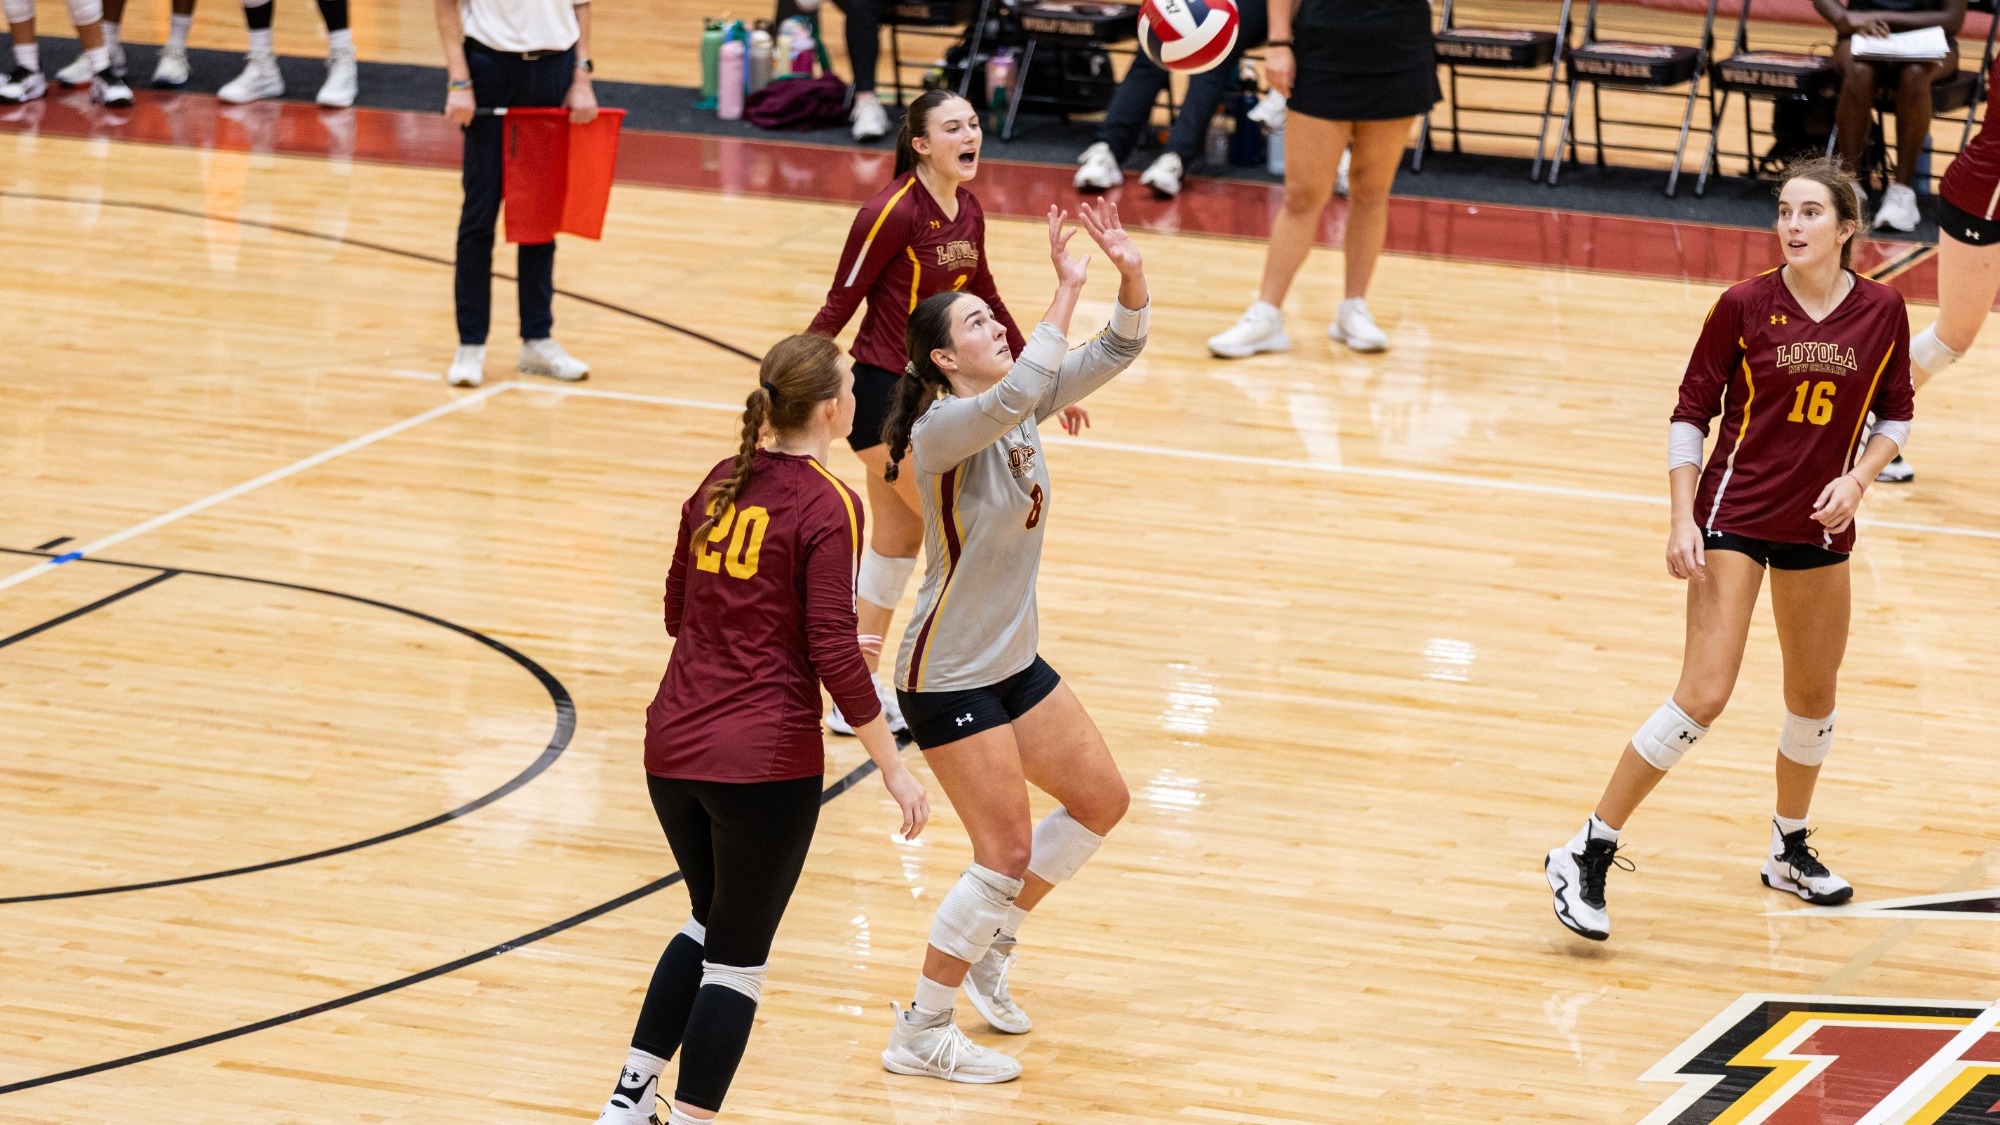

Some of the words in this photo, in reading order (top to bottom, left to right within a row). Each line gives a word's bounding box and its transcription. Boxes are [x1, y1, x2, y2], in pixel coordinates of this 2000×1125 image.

[1615, 63, 1652, 78] PACK
[1761, 71, 1798, 88] PACK
[1776, 342, 1858, 371] LOYOLA
[1788, 363, 1810, 374] NEW
[1809, 363, 1847, 376] ORLEANS
[1787, 380, 1837, 426] 16
[1025, 483, 1044, 530] 8
[696, 497, 770, 580] 20
